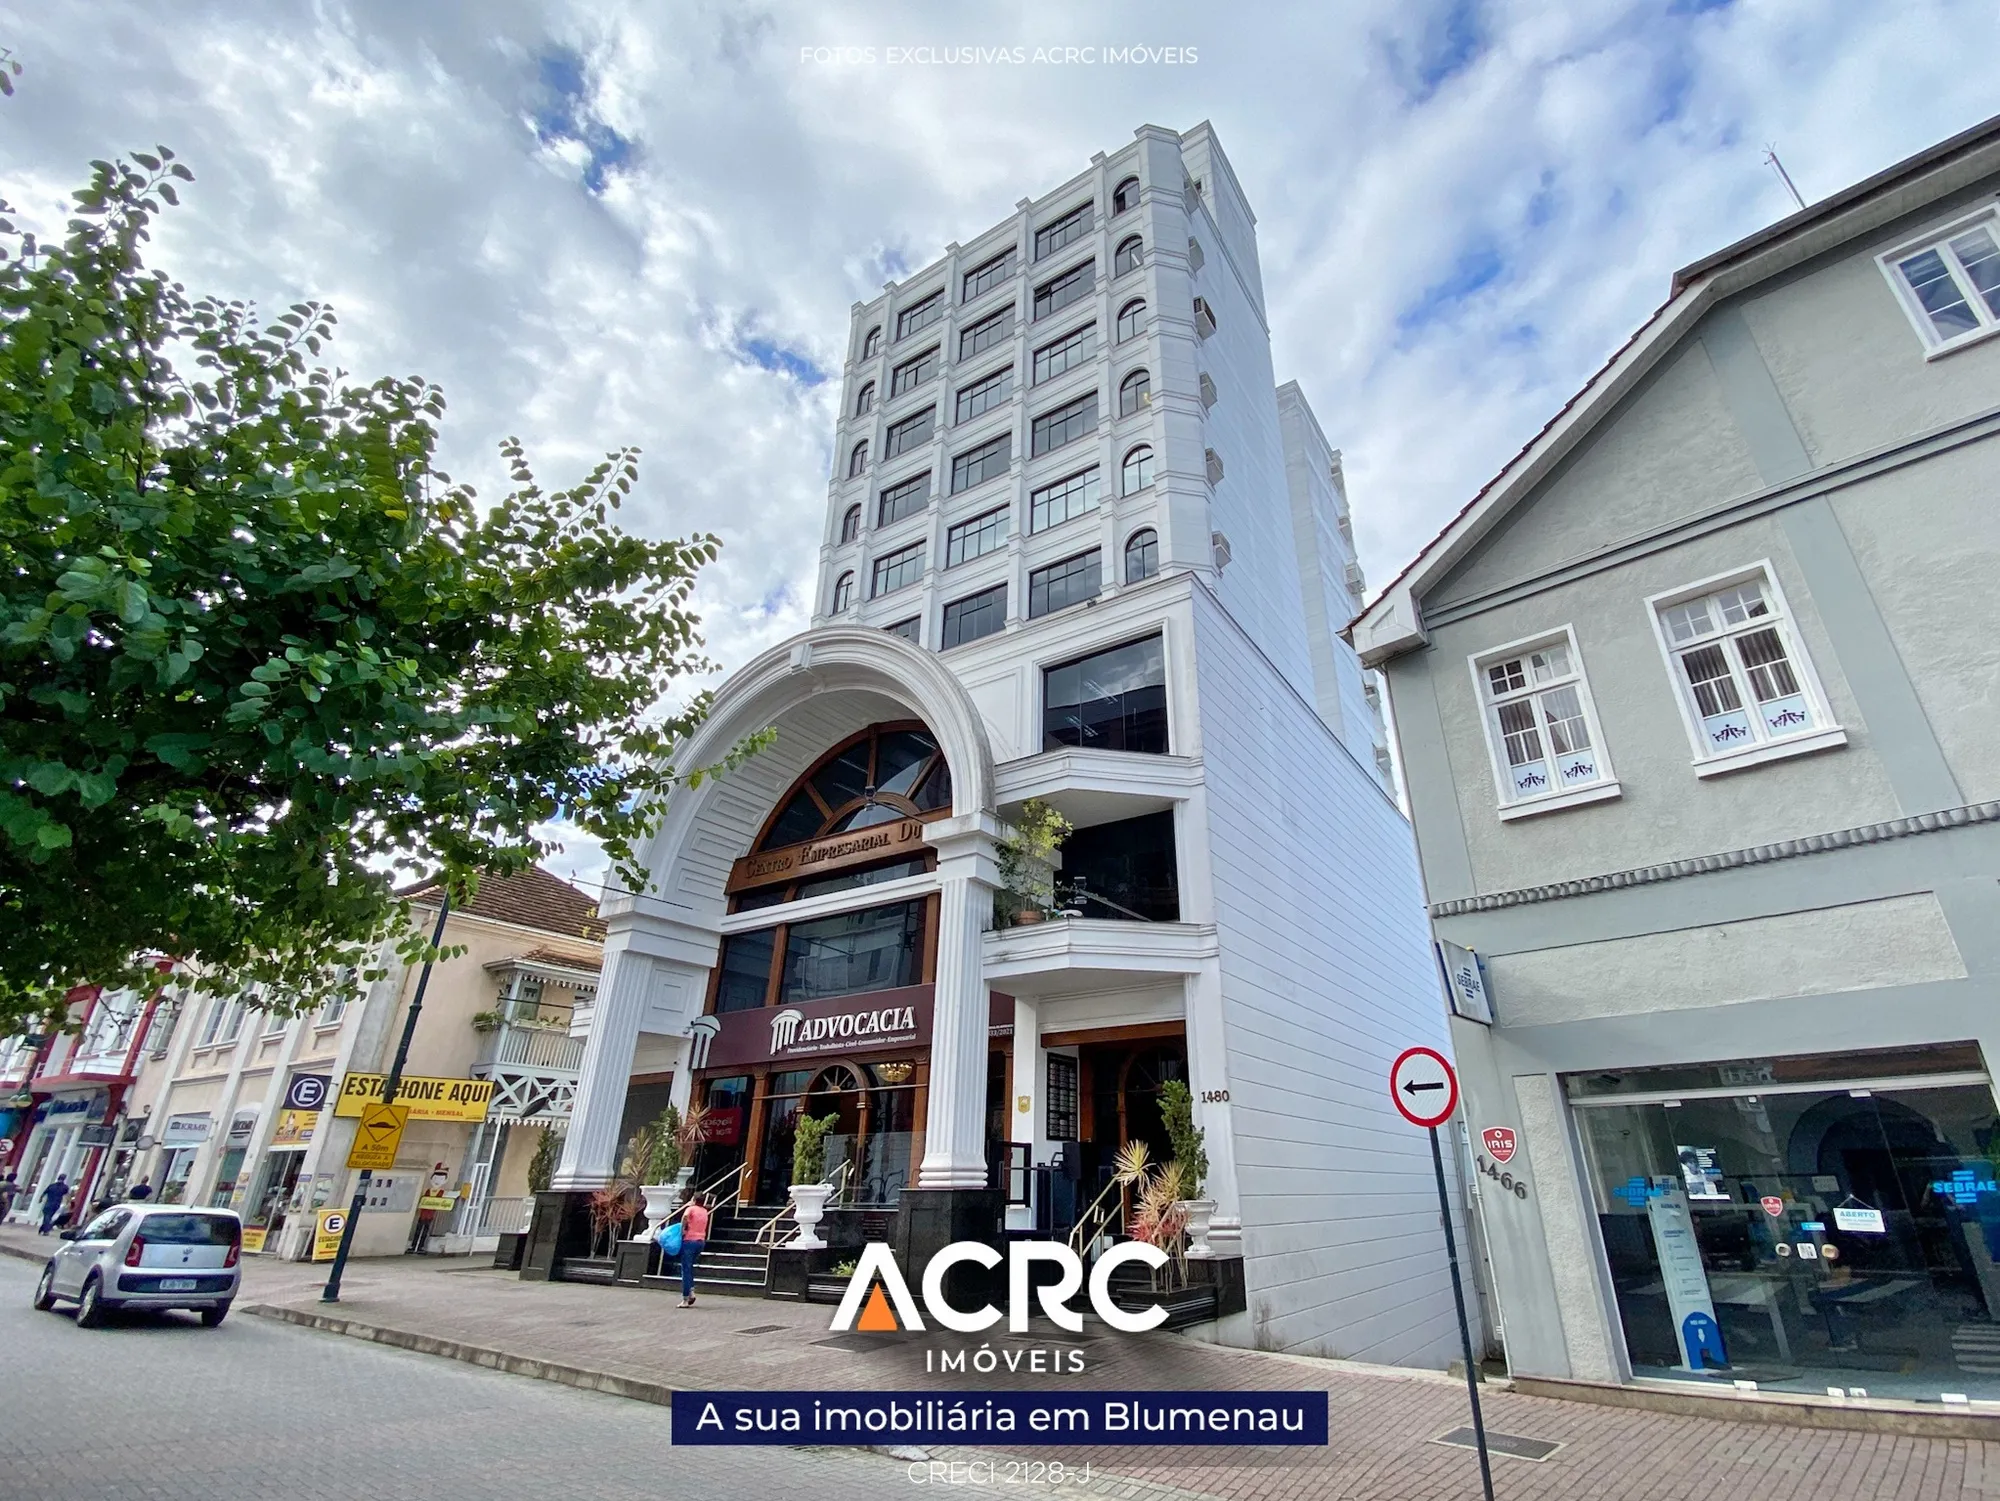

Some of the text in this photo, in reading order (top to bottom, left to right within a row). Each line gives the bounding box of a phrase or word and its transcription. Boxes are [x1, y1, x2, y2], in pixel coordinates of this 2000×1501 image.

[745, 857, 794, 879] CENTRO
[799, 833, 891, 866] EMPRESARIAL
[1456, 973, 1480, 993] SEBRAE
[798, 1006, 915, 1042] ADVOCACIA
[298, 1082, 318, 1102] E
[448, 1083, 491, 1106] AQUI
[1201, 1090, 1230, 1103] 1480
[1487, 1140, 1513, 1149] IRIS
[1476, 1154, 1526, 1200] 1466
[1612, 1187, 1663, 1198] SEBRAE
[1933, 1181, 1997, 1193] SEBRAE
[1840, 1210, 1876, 1219] ABERTO
[328, 1217, 341, 1230] E
